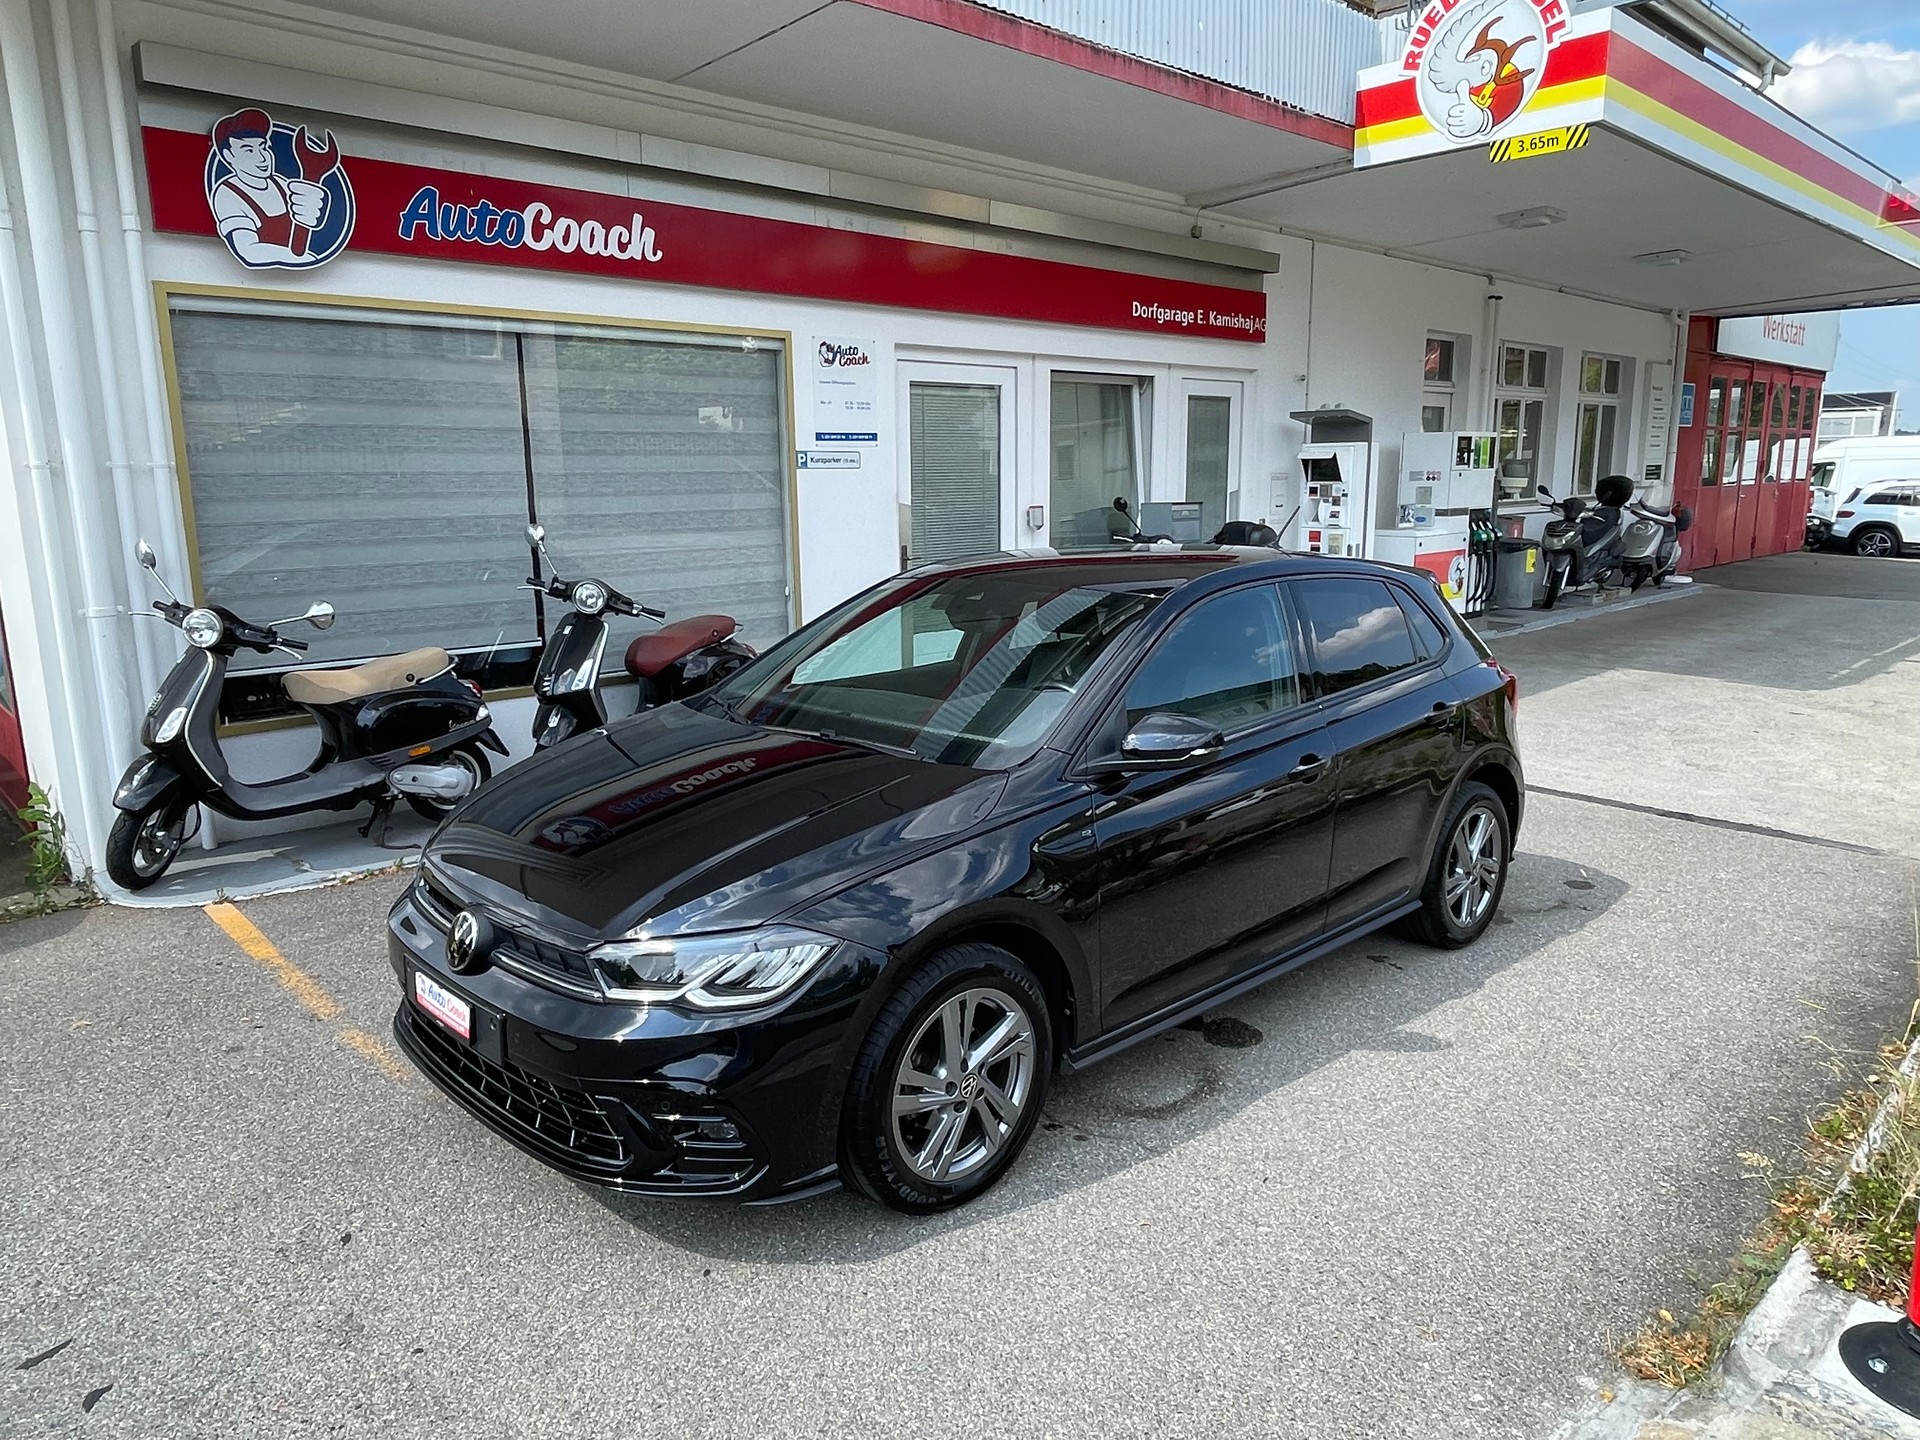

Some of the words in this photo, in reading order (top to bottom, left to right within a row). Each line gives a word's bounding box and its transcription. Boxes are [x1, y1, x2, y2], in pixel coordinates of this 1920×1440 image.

[1530, 0, 1566, 44] EL
[1517, 136, 1559, 153] 3.65m
[398, 186, 663, 262] AutoCoach
[1132, 301, 1195, 327] Dorfgarage
[1197, 310, 1206, 324] E.
[1763, 315, 1806, 346] Werkstatt
[835, 344, 859, 356] Auto
[839, 352, 870, 367] Coach
[798, 453, 807, 467] P
[810, 456, 842, 464] Kurzparker
[428, 984, 446, 1009] Auto
